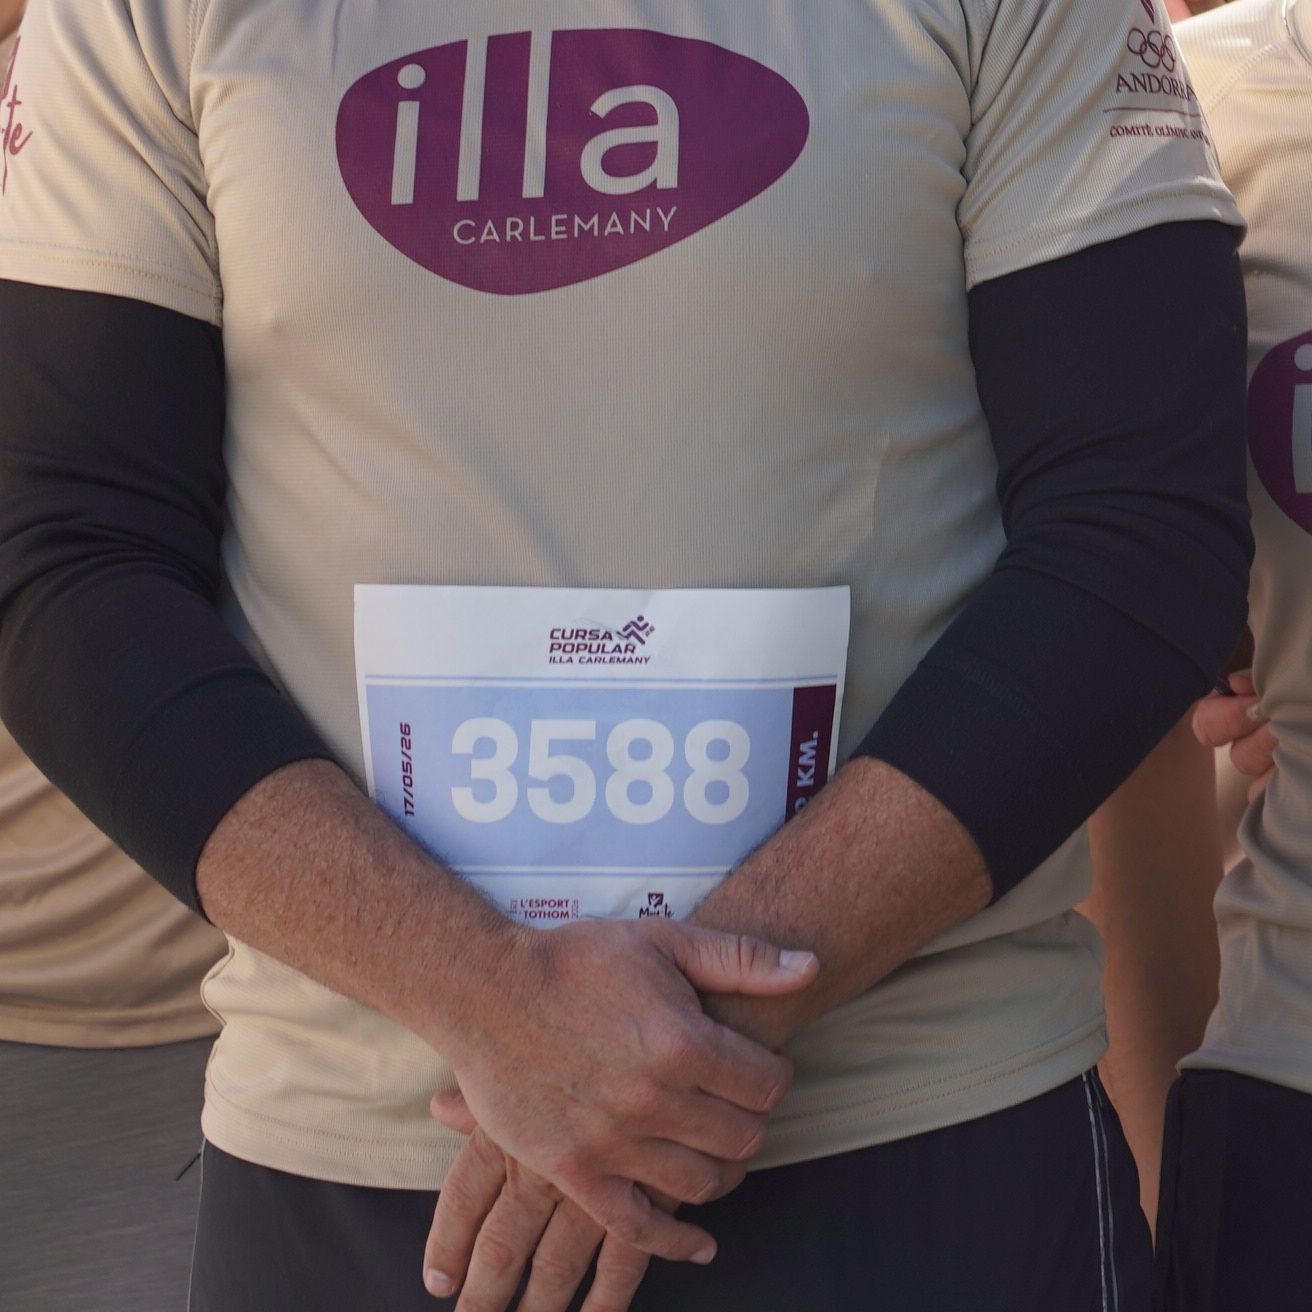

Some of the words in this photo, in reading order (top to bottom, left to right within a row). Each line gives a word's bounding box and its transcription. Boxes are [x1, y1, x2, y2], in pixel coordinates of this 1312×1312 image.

[392, 31, 680, 205] illa
[452, 205, 678, 246] CARLEMANY
[549, 628, 613, 641] CURSA
[549, 642, 636, 654] POPULAR
[549, 656, 574, 664] ILLA
[578, 656, 651, 664] CARLEMANY
[400, 721, 416, 817] 17/05/26
[451, 717, 751, 825] 3588
[796, 730, 820, 788] KM.
[520, 898, 570, 908] L'ESPORT
[523, 910, 570, 919] TOTHOM
